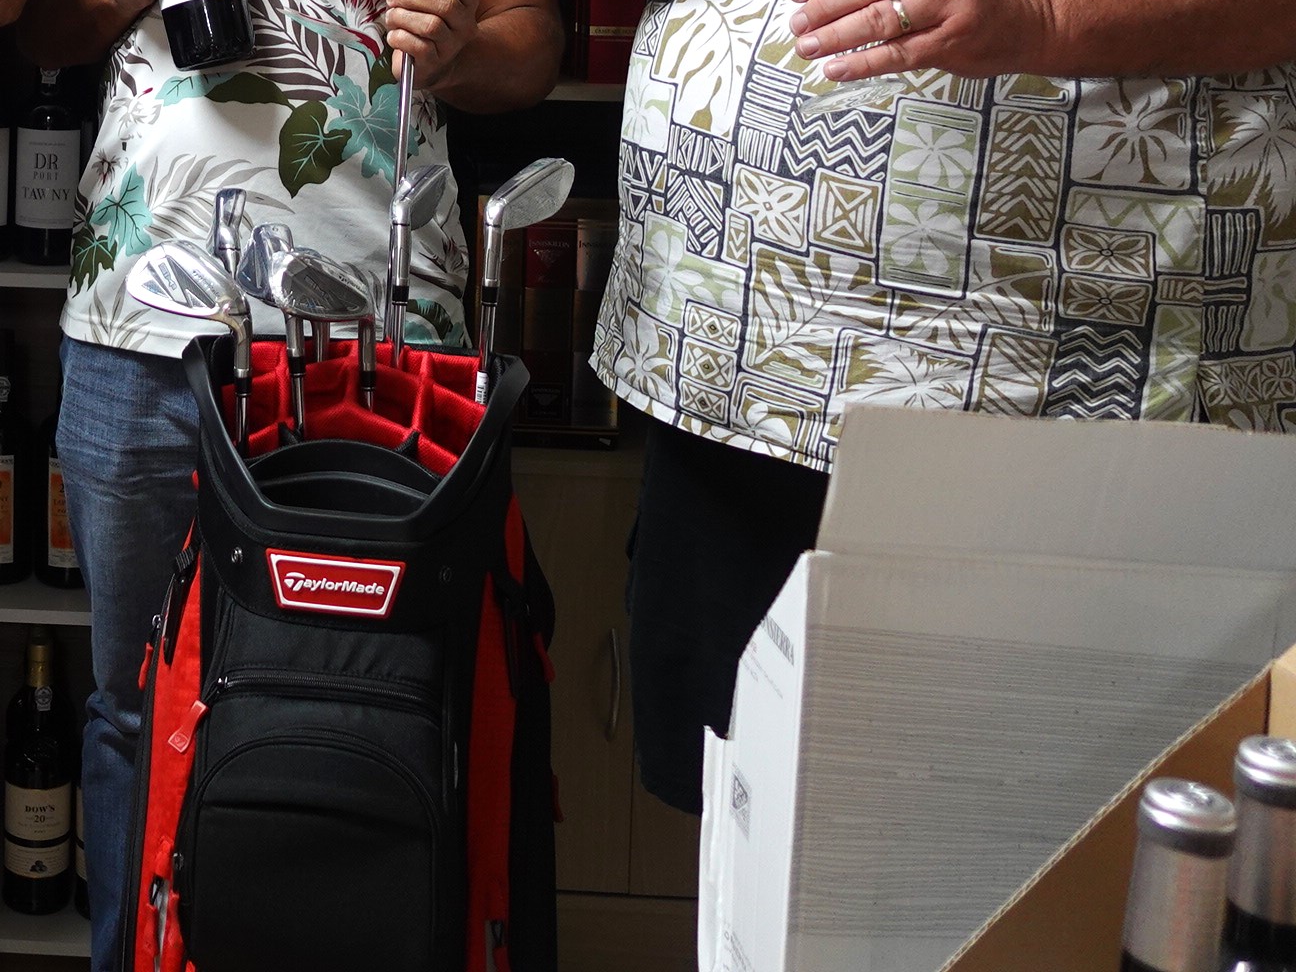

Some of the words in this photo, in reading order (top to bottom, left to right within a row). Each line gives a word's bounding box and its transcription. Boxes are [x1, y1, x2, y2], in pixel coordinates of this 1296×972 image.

[36, 153, 59, 169] DR
[33, 171, 59, 181] PORT
[23, 188, 71, 201] TAWNY
[284, 571, 385, 595] TaylorMade
[24, 804, 55, 813] DOW'S
[34, 814, 46, 823] 20
